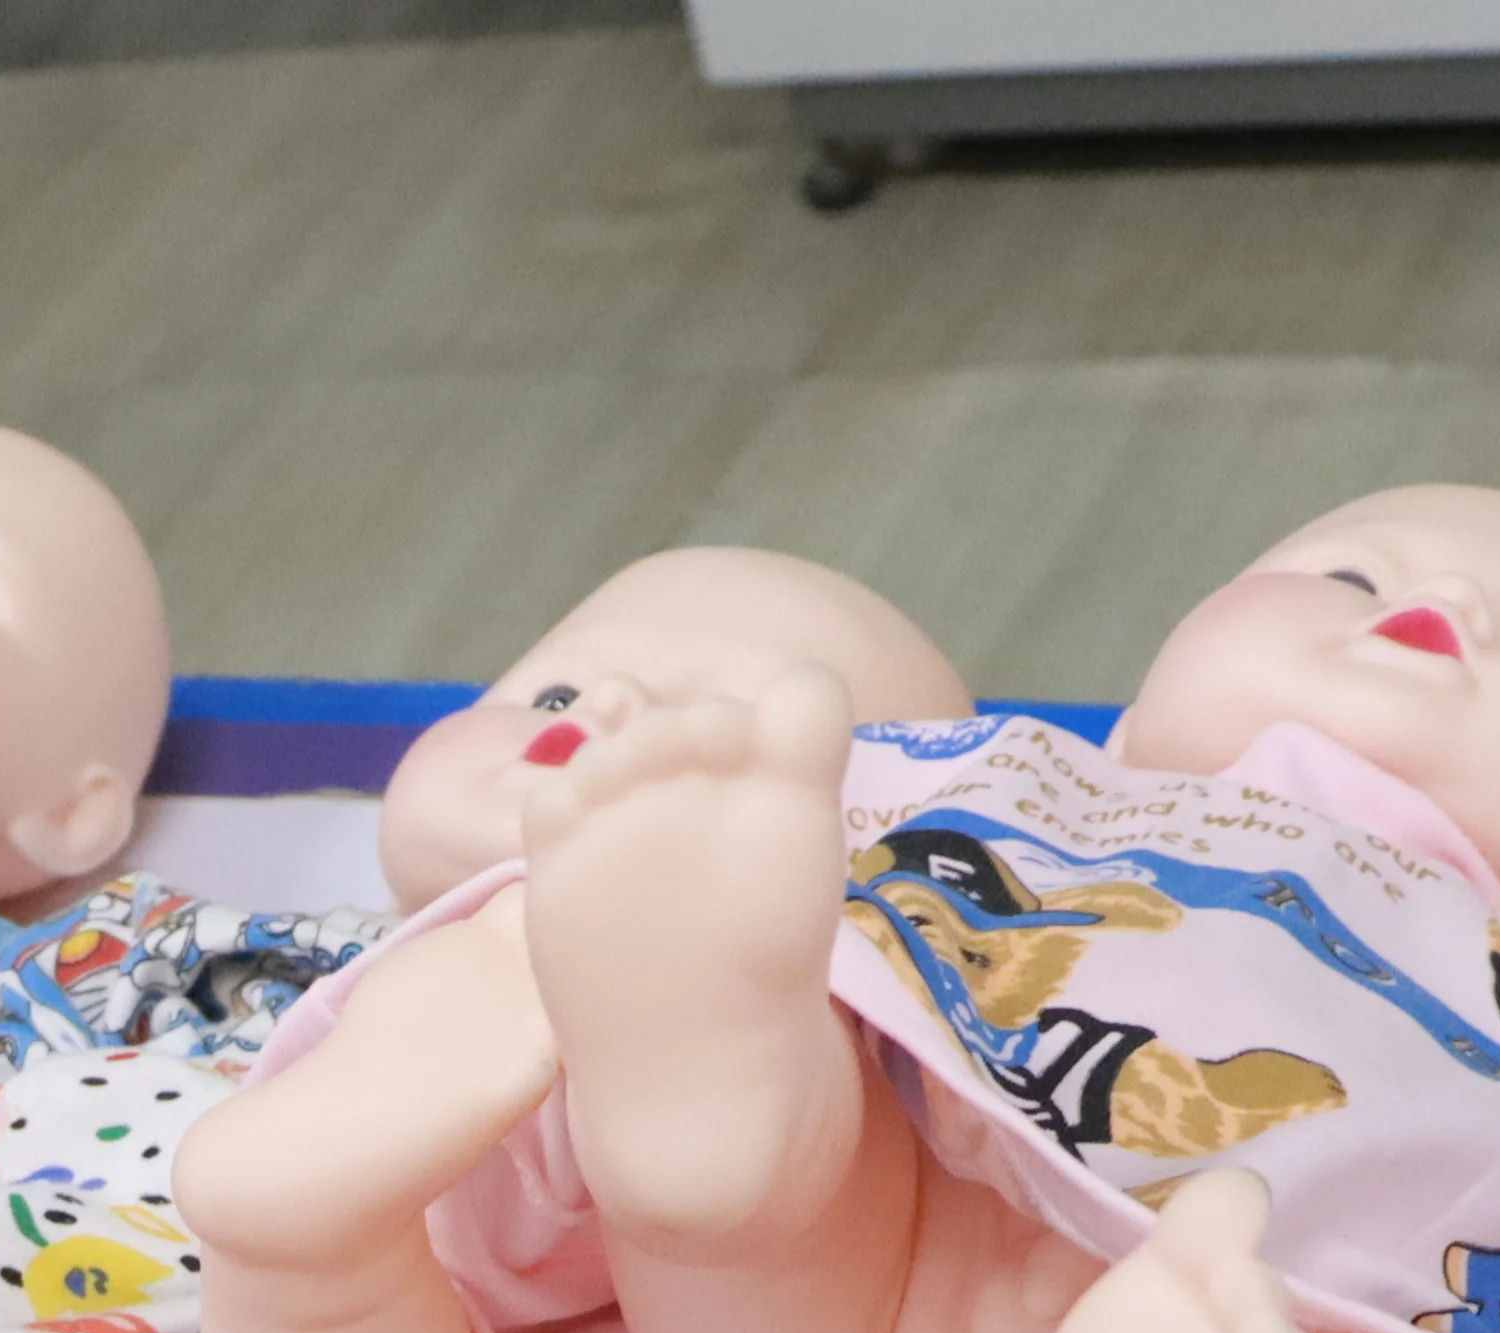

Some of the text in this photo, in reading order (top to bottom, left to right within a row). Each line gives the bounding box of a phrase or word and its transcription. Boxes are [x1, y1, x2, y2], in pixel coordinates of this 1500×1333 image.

[1014, 797, 1212, 853] enemies
[1081, 800, 1177, 824] and
[1202, 811, 1306, 840] who
